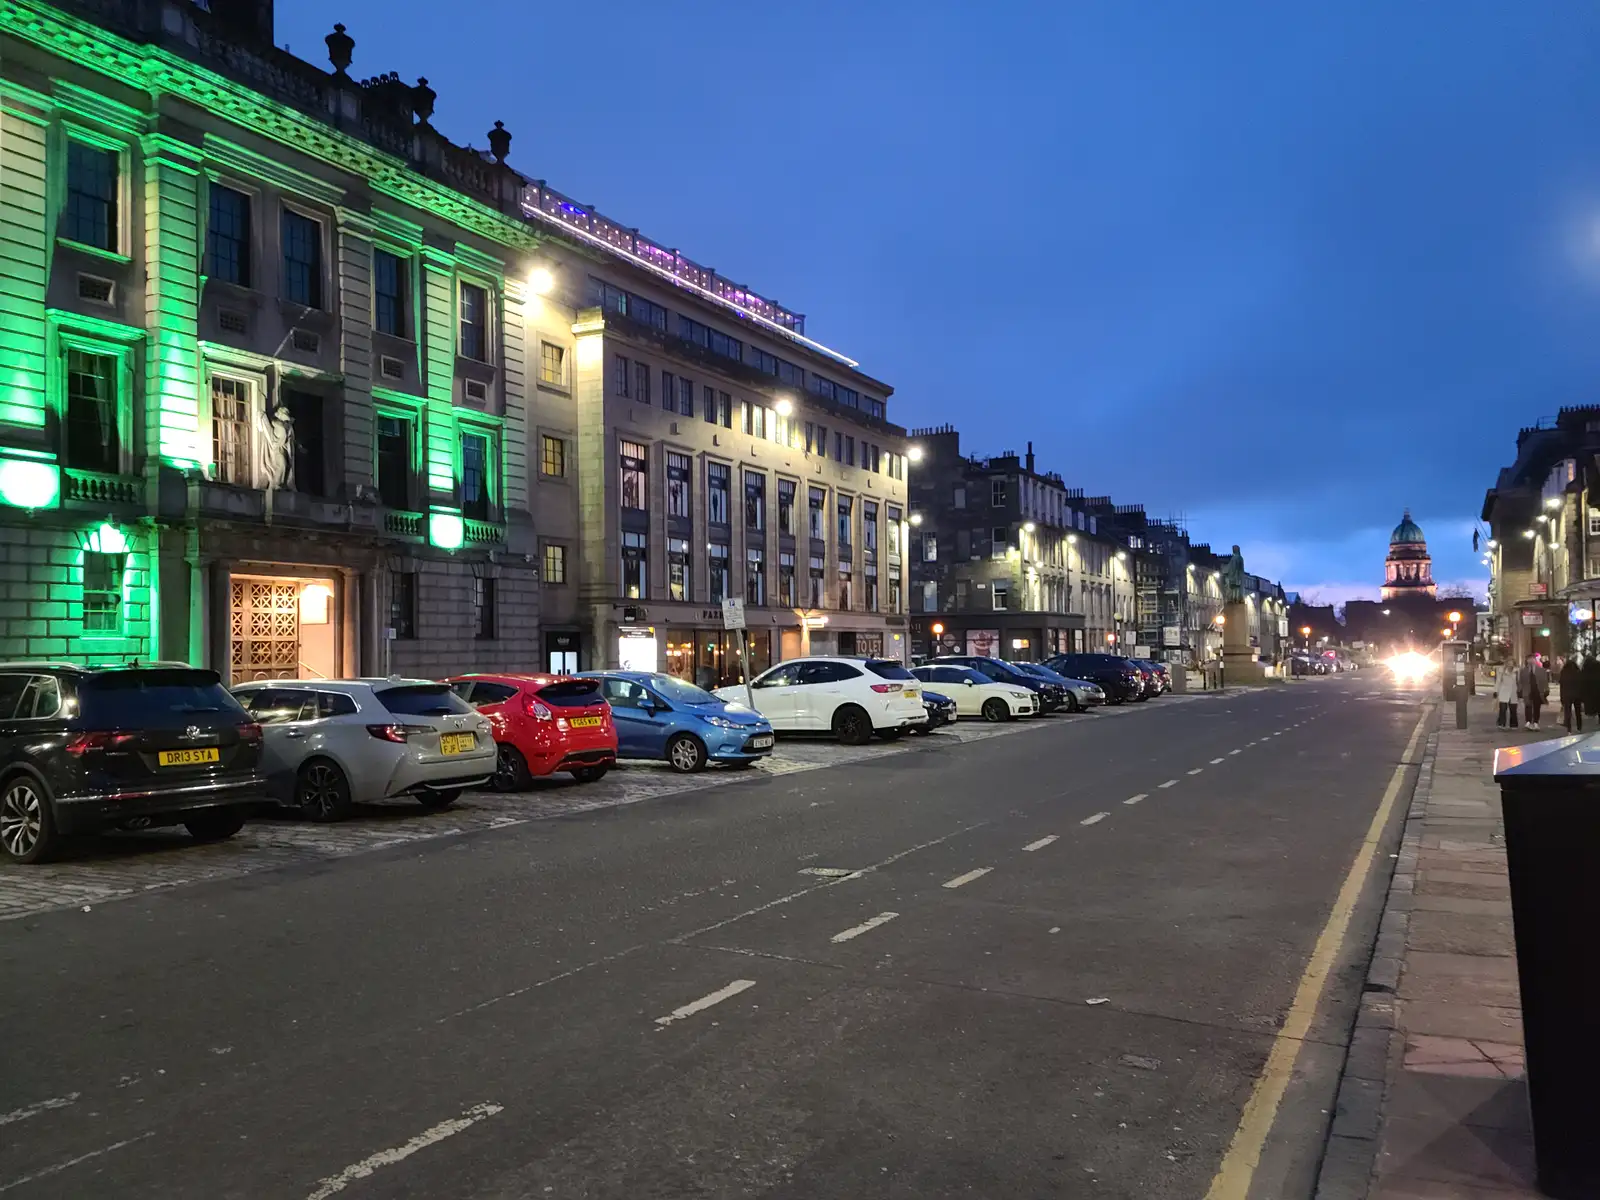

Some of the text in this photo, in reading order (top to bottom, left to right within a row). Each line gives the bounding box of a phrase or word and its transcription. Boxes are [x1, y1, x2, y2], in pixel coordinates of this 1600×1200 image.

[856, 640, 882, 653] TO LET
[167, 750, 213, 763] DR13 STA
